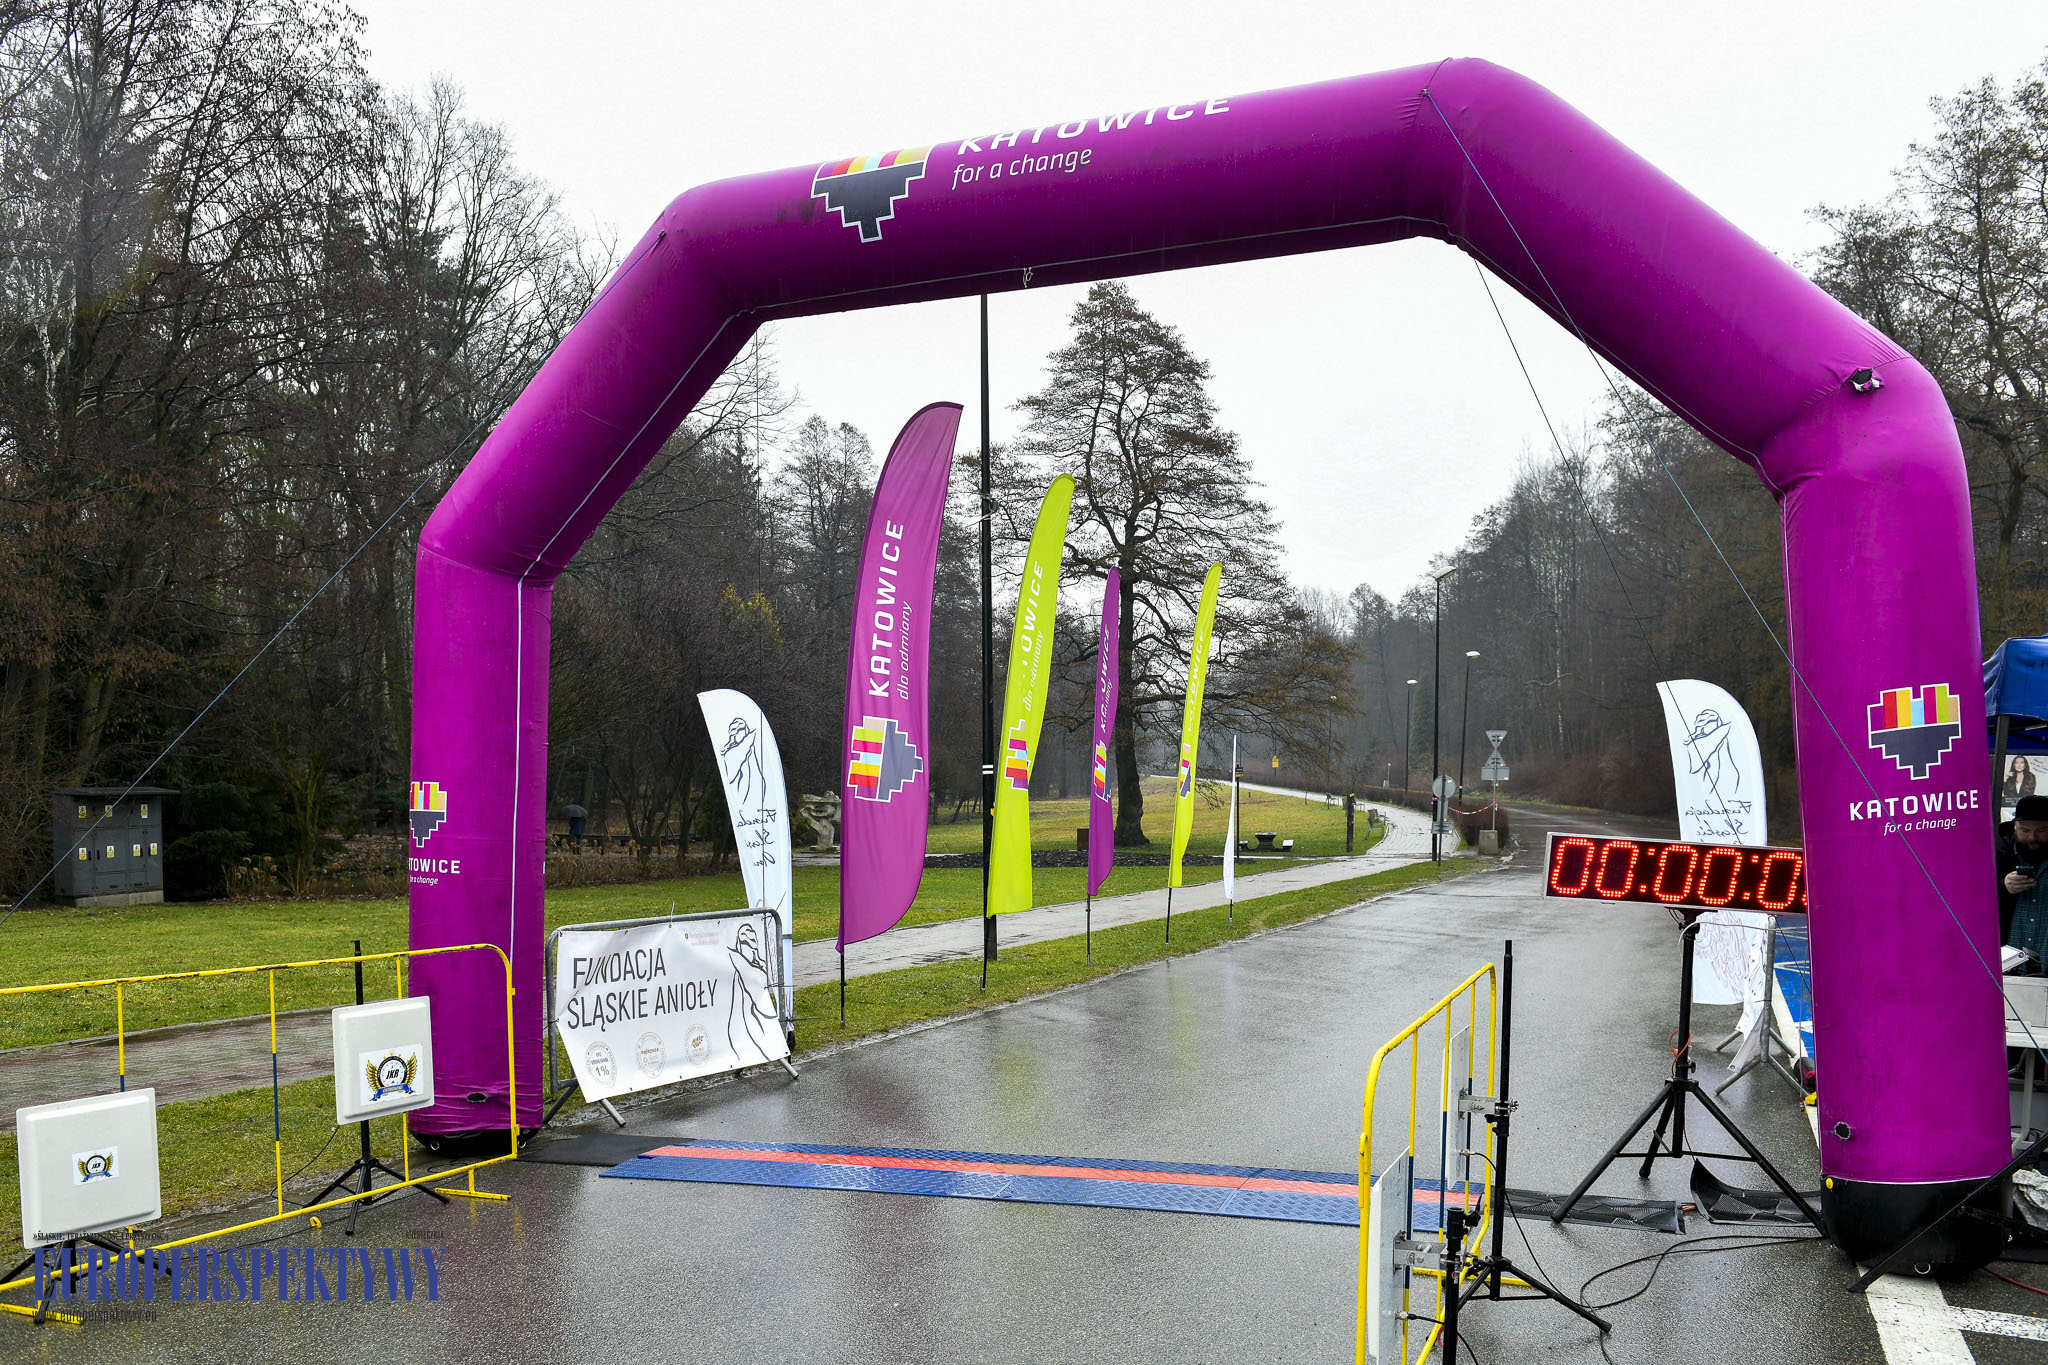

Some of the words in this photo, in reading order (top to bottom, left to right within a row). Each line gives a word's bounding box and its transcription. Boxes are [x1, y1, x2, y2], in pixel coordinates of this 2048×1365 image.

[951, 163, 985, 190] for
[988, 162, 1002, 179] a
[1010, 147, 1092, 176] change
[868, 519, 904, 697] KATOWICE
[898, 600, 913, 672] odmiany
[897, 673, 909, 700] dla
[1849, 789, 1979, 821] KATOWICE
[1884, 822, 1902, 836] for
[1904, 822, 1912, 831] a
[1916, 818, 1957, 830] change
[408, 857, 461, 874] TOWICE
[1551, 837, 1808, 910] 00:00:0
[572, 948, 667, 989] FUNDACJA
[654, 979, 718, 1016] ANIOŁY
[595, 1065, 610, 1077] 1%
